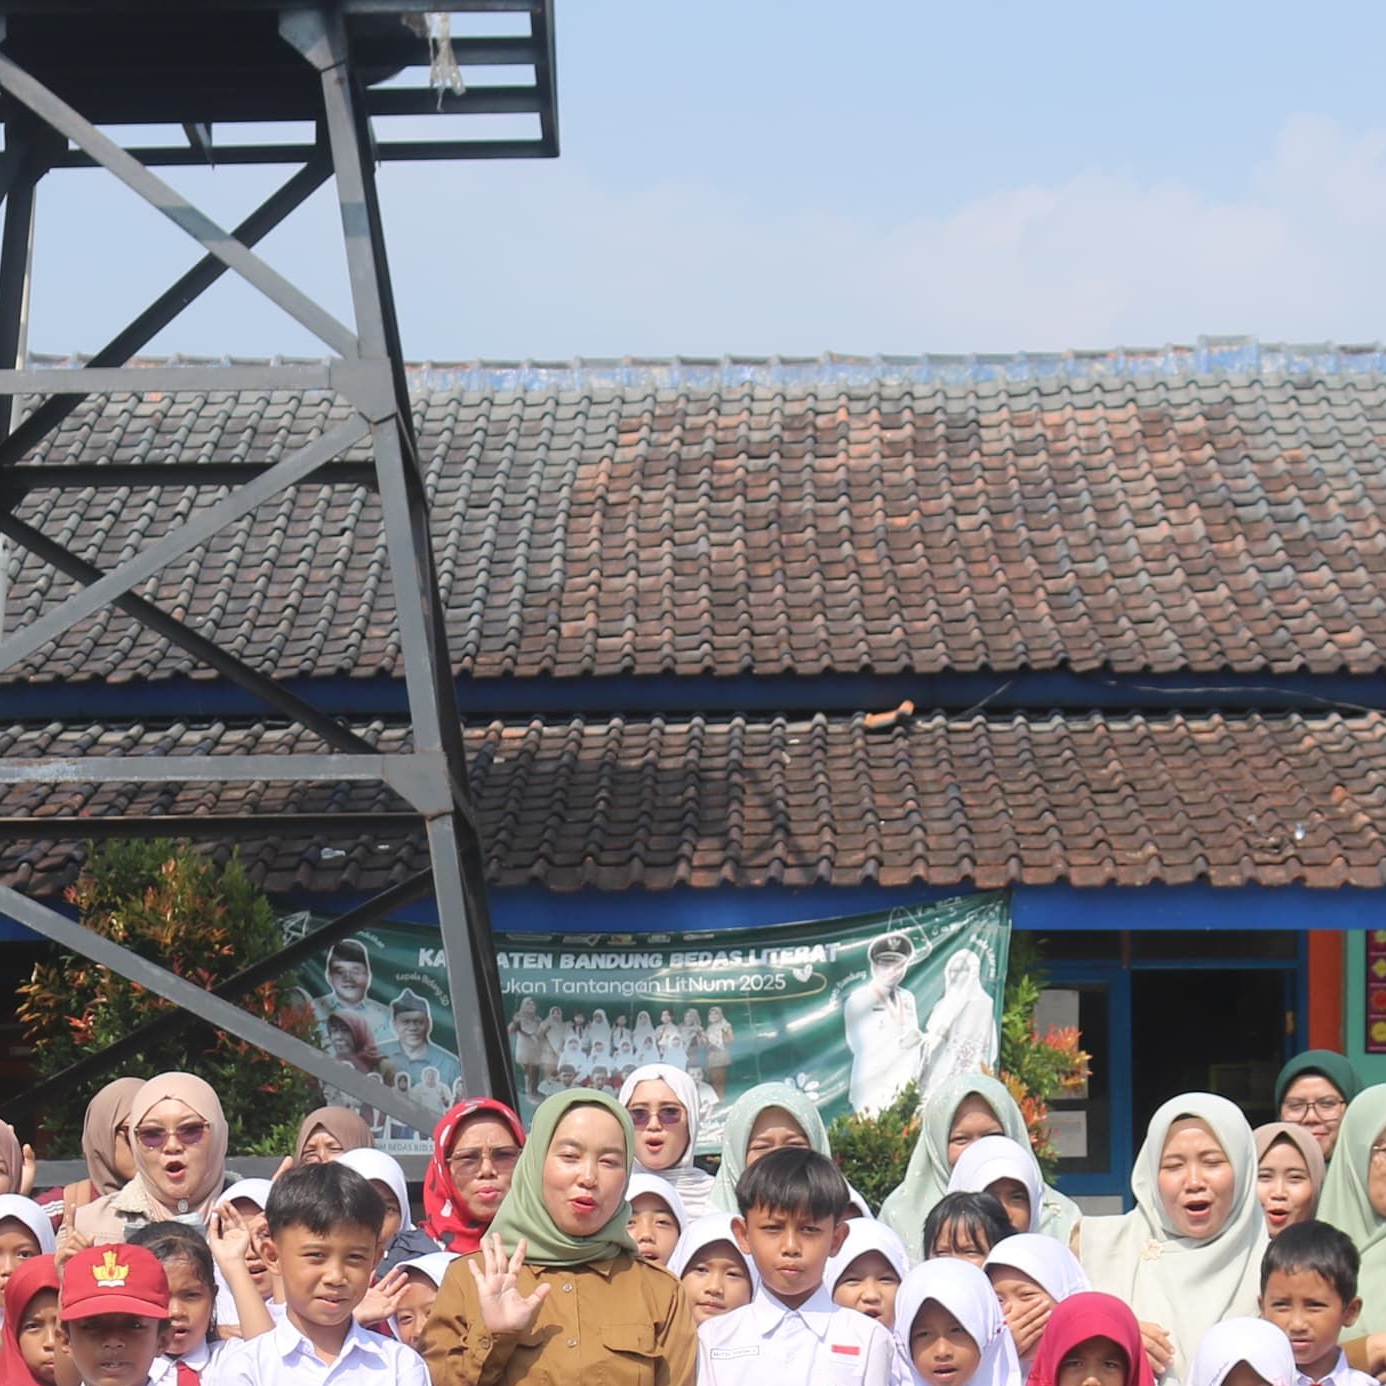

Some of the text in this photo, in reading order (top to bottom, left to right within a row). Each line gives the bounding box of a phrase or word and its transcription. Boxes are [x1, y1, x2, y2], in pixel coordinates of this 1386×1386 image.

[418, 942, 841, 969] KAATEN BANDUNG BEDAS LITERAT
[551, 978, 660, 996] Tantangan
[665, 977, 736, 993] LitNum
[739, 974, 786, 991] 2025
